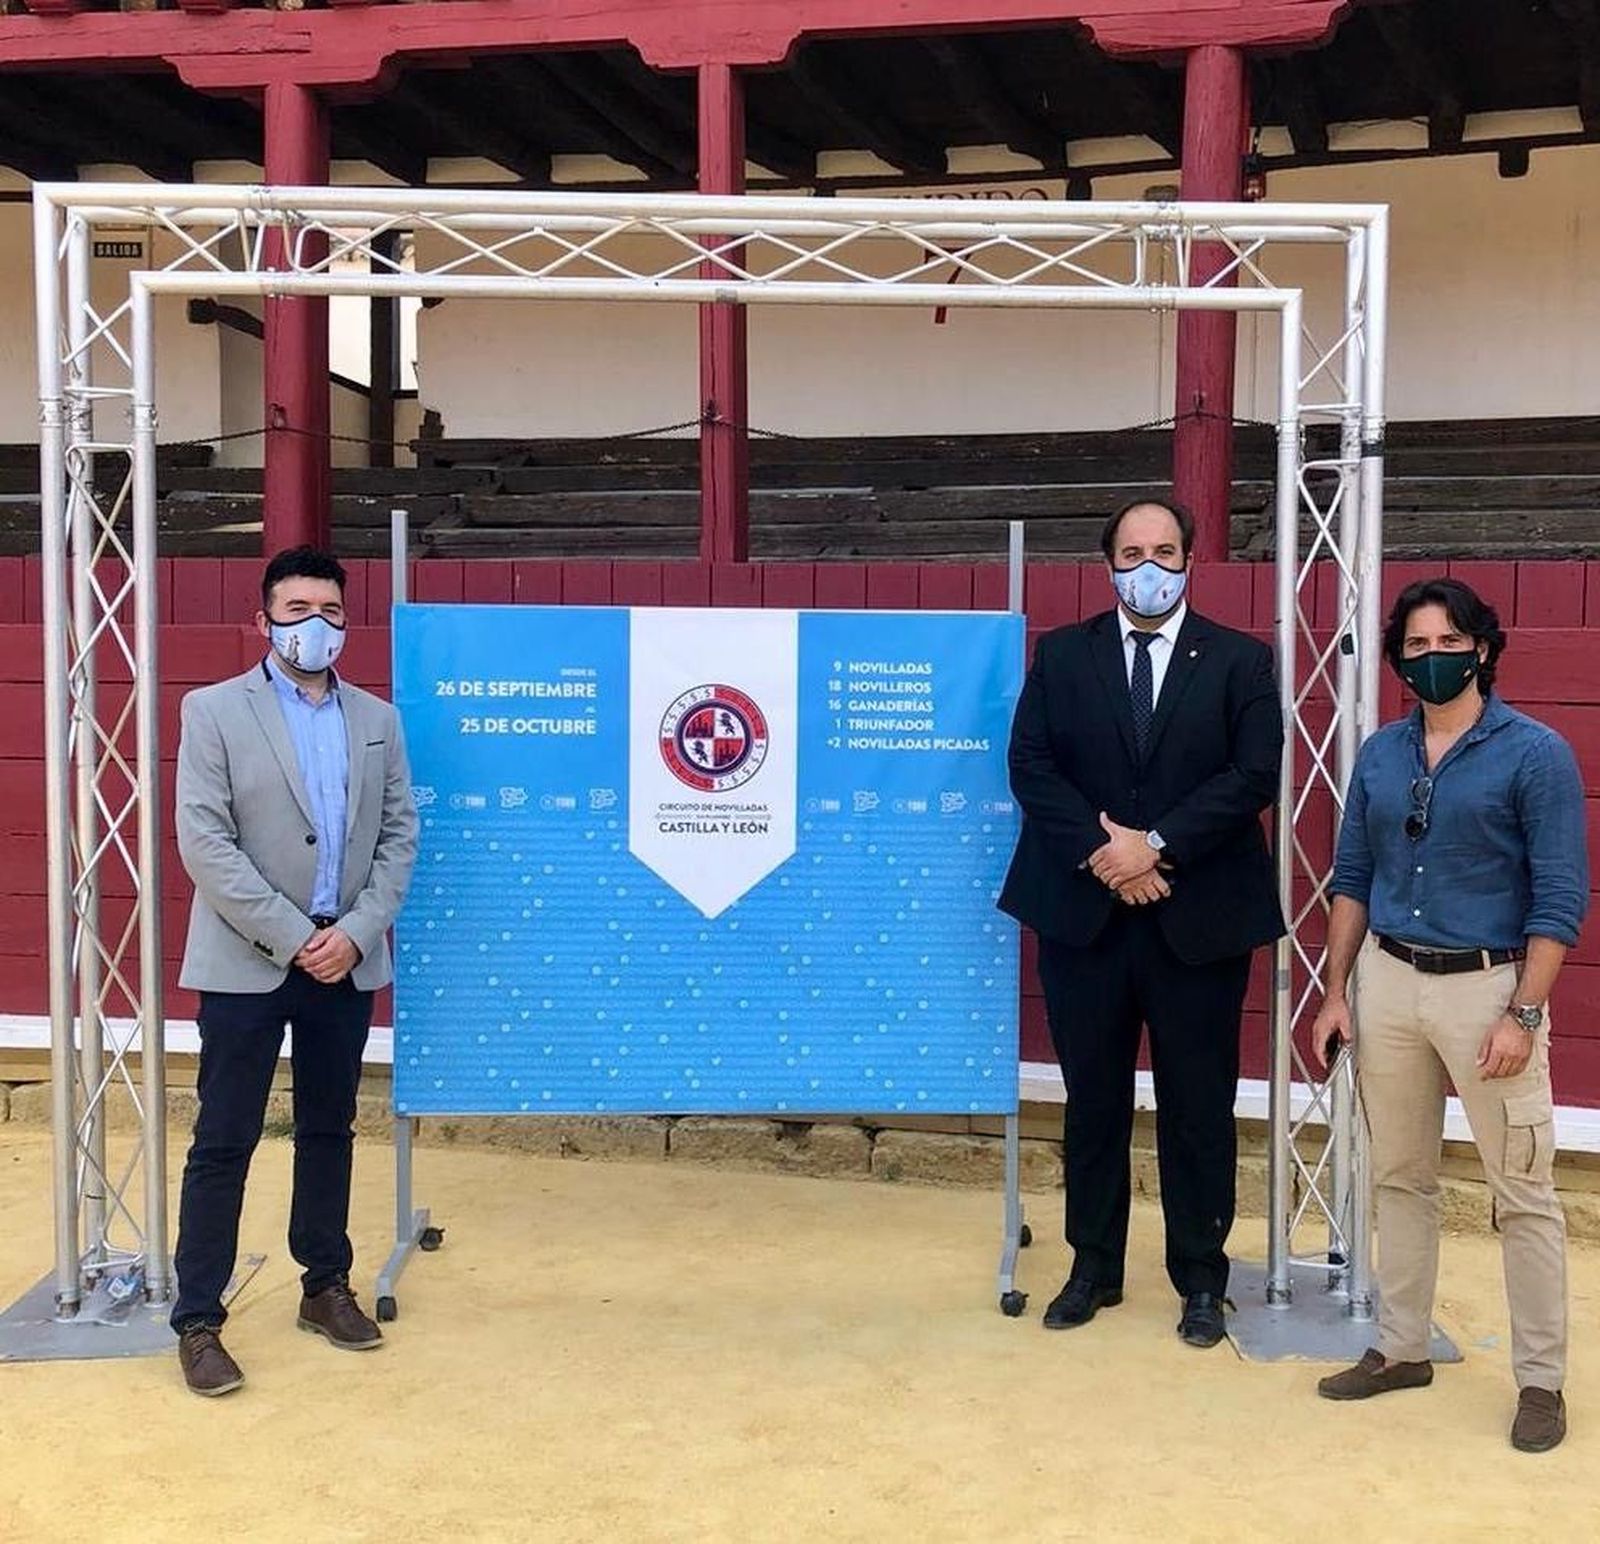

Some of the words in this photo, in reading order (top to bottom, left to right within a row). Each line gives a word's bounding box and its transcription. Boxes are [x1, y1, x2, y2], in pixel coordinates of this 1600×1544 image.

[833, 661, 842, 673] 9
[848, 661, 933, 675] NOVILLADAS
[435, 681, 455, 697] 26
[459, 681, 484, 697] DE
[487, 681, 597, 698] SEPTIEMBRE
[828, 680, 842, 692] 18
[848, 681, 932, 694] NOVILLEROS
[828, 699, 842, 711] 16
[848, 699, 934, 713] GANADERÍAS
[460, 718, 480, 734] 25
[484, 718, 509, 734] DE
[512, 718, 597, 735] OCTUBRE
[835, 719, 841, 730] 1
[848, 719, 934, 731] TRIUNFADOR
[848, 738, 931, 750] NOVILLADAS
[934, 739, 990, 751] PICADAS
[658, 803, 700, 811] CIRCUITO
[701, 803, 713, 811] DE
[714, 804, 768, 812] NOVILLADAS
[658, 822, 719, 833] CASTILLA
[721, 822, 730, 833] Y
[733, 820, 768, 834] LEÓN
